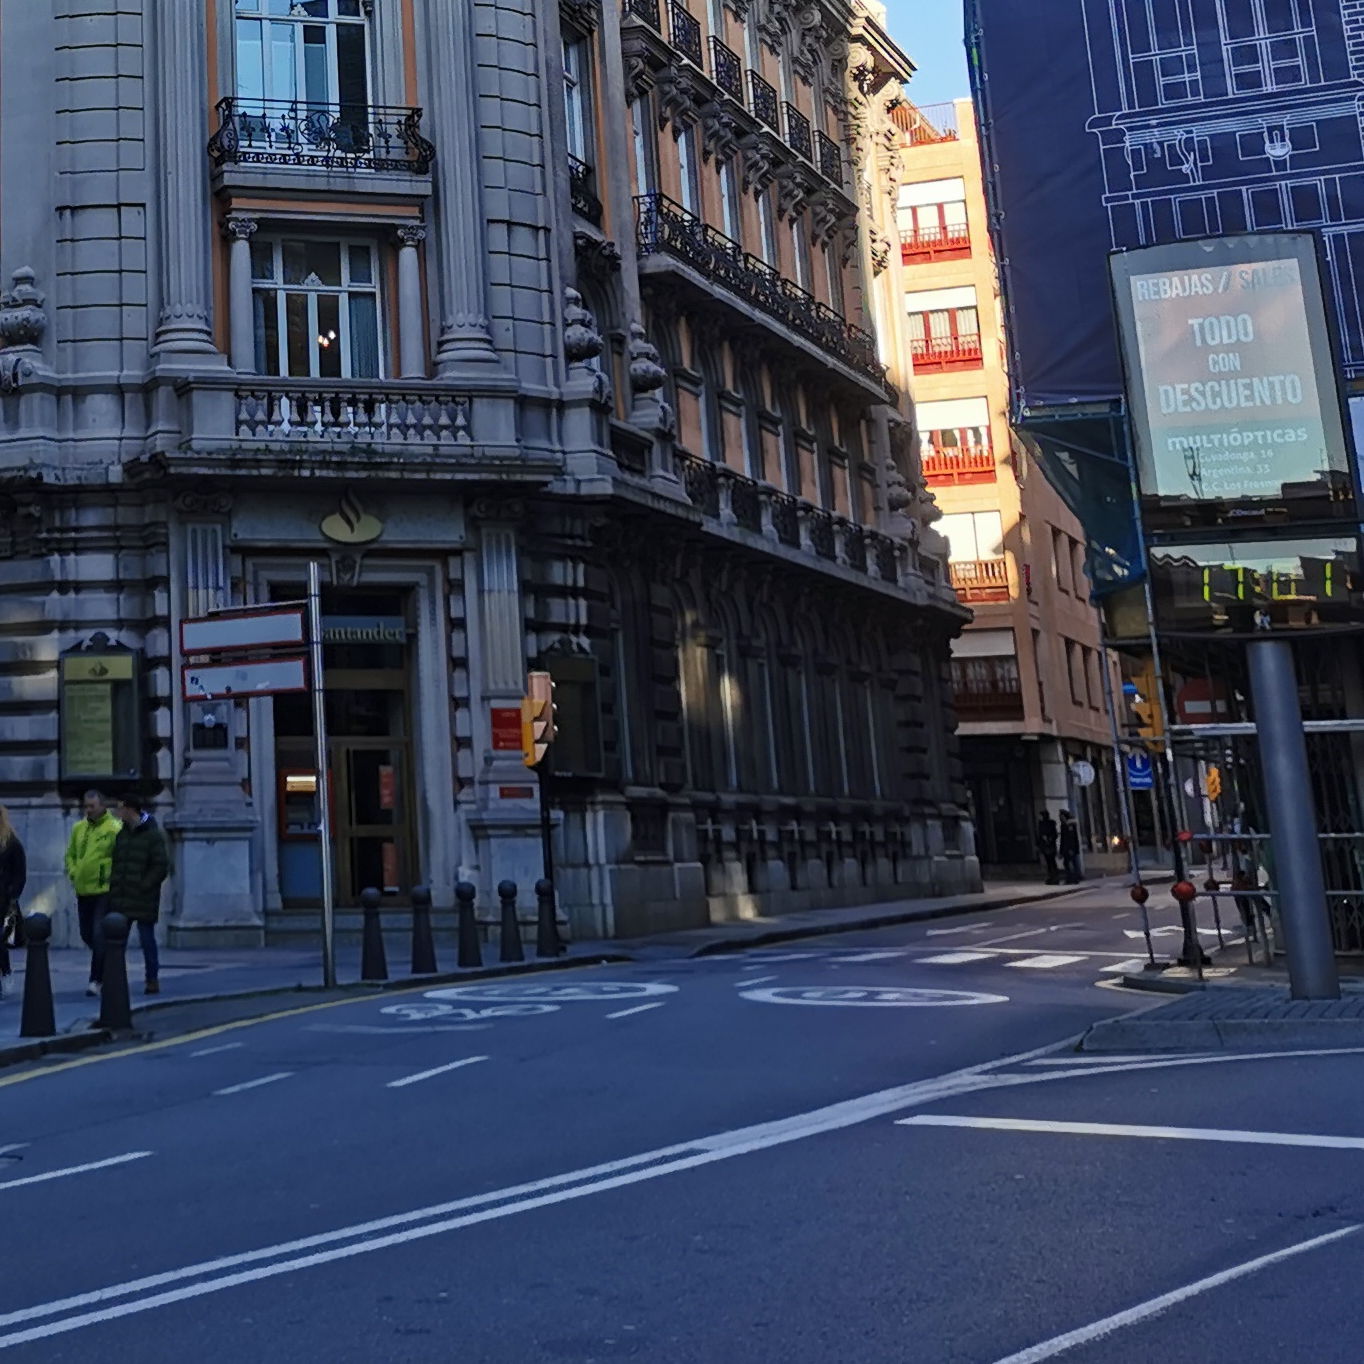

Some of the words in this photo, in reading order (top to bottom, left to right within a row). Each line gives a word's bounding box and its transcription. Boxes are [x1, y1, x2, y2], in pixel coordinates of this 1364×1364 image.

[1137, 272, 1214, 301] REBAJAS
[1188, 313, 1255, 348] TODO
[1208, 352, 1242, 374] CON
[1158, 373, 1304, 416] DESCUENTO
[323, 620, 403, 641] antander
